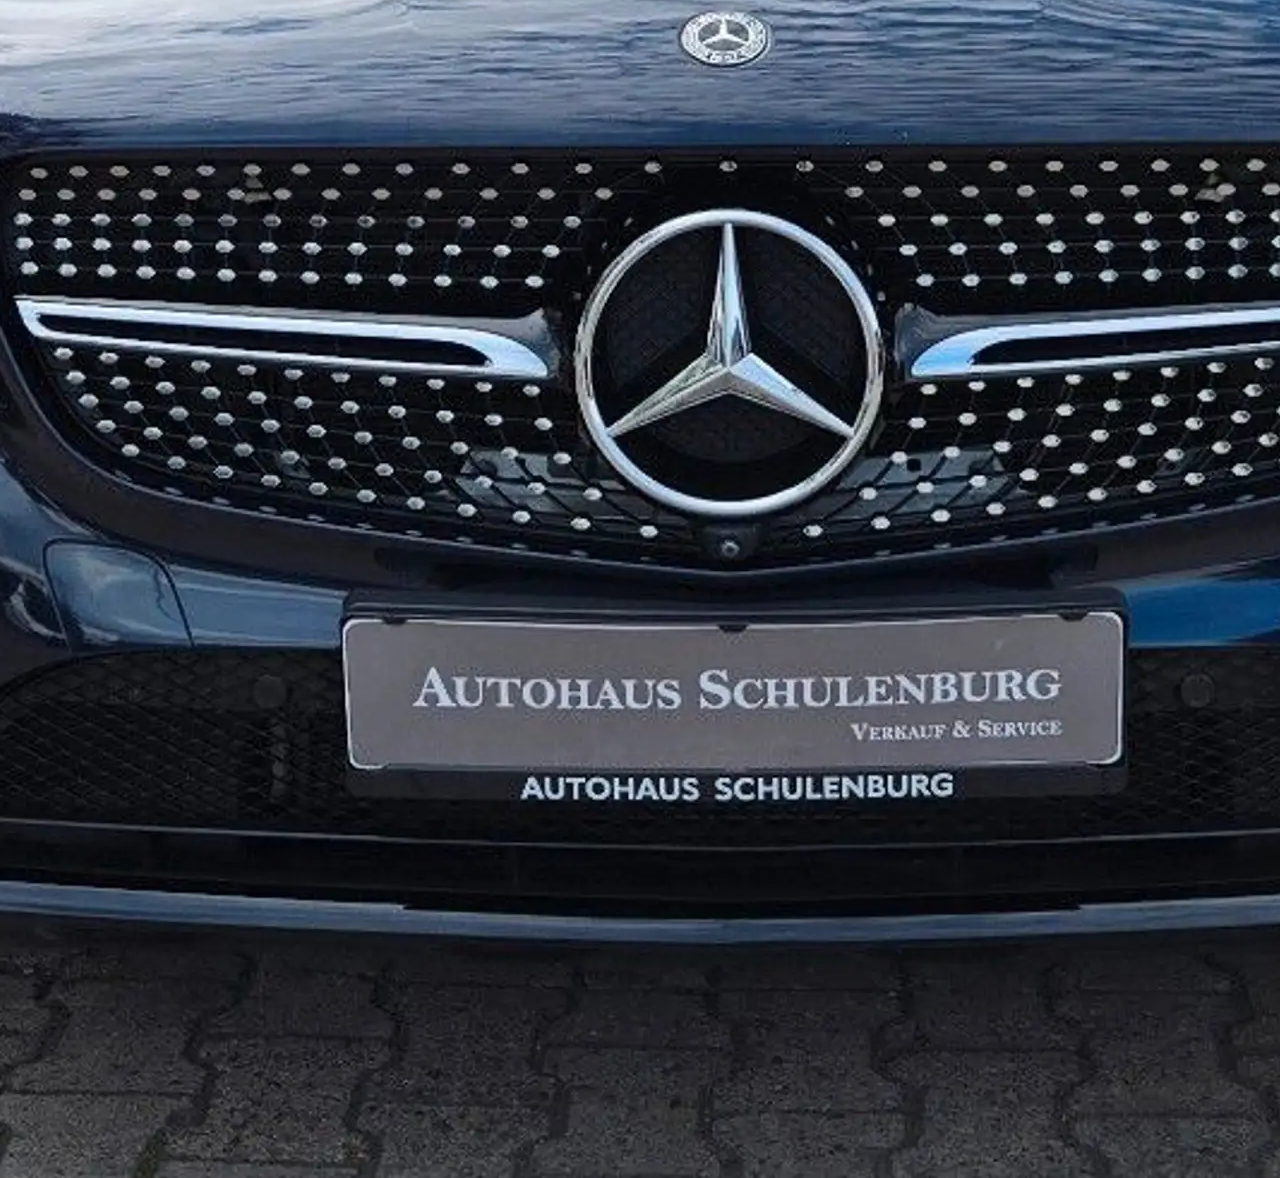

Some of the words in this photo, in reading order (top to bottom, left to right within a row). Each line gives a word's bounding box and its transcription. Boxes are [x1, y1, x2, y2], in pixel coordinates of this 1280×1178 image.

[412, 666, 682, 710] AUTOHAUS
[699, 669, 1062, 711] SCHULENBURG
[850, 722, 947, 741] VERKAUF
[951, 720, 974, 740] &
[977, 719, 1063, 738] SERVICE
[520, 776, 700, 803] AUTOHAUS
[714, 772, 954, 801] SCHULENBURG
